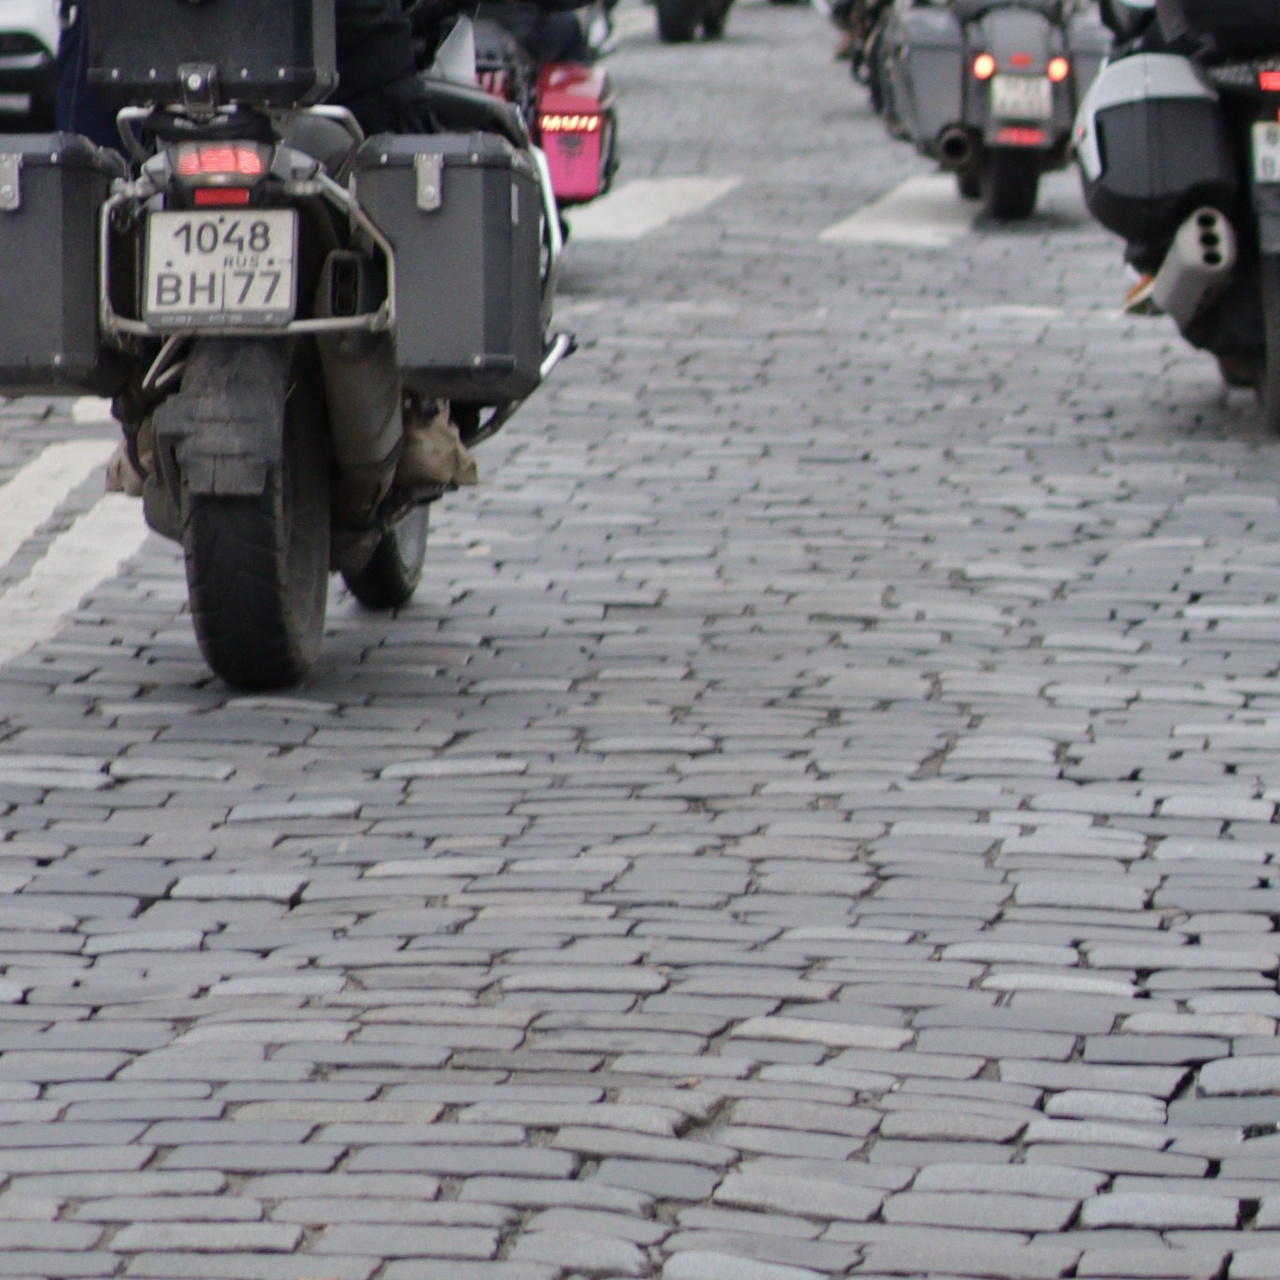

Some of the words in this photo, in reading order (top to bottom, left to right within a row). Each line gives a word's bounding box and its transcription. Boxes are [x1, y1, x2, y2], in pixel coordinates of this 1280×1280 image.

[173, 220, 271, 254] 1048
[223, 255, 260, 269] RUS
[233, 271, 282, 305] 77
